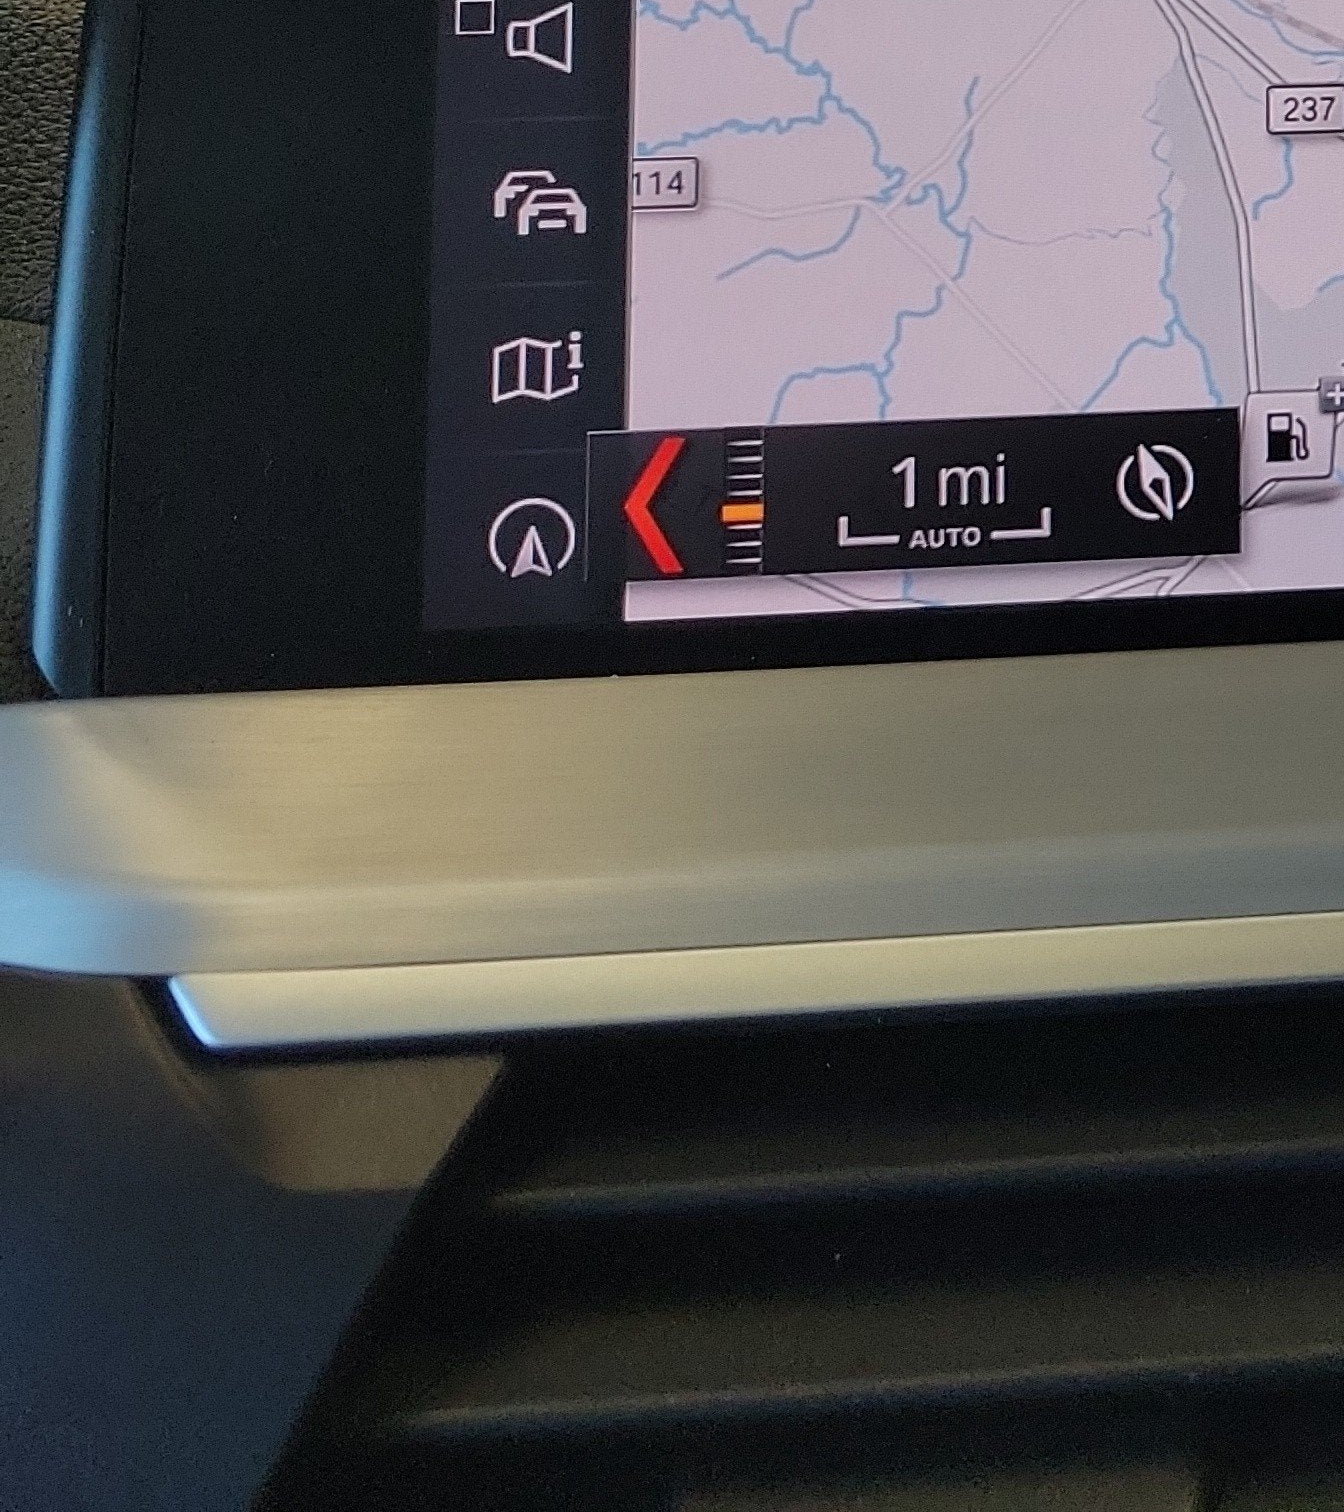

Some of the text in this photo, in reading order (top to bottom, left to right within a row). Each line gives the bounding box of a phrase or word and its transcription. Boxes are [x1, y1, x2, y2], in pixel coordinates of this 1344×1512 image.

[1282, 98, 1334, 121] 237
[633, 170, 682, 195] 114
[892, 454, 1006, 509] 1 mi
[909, 526, 981, 548] AUTO
